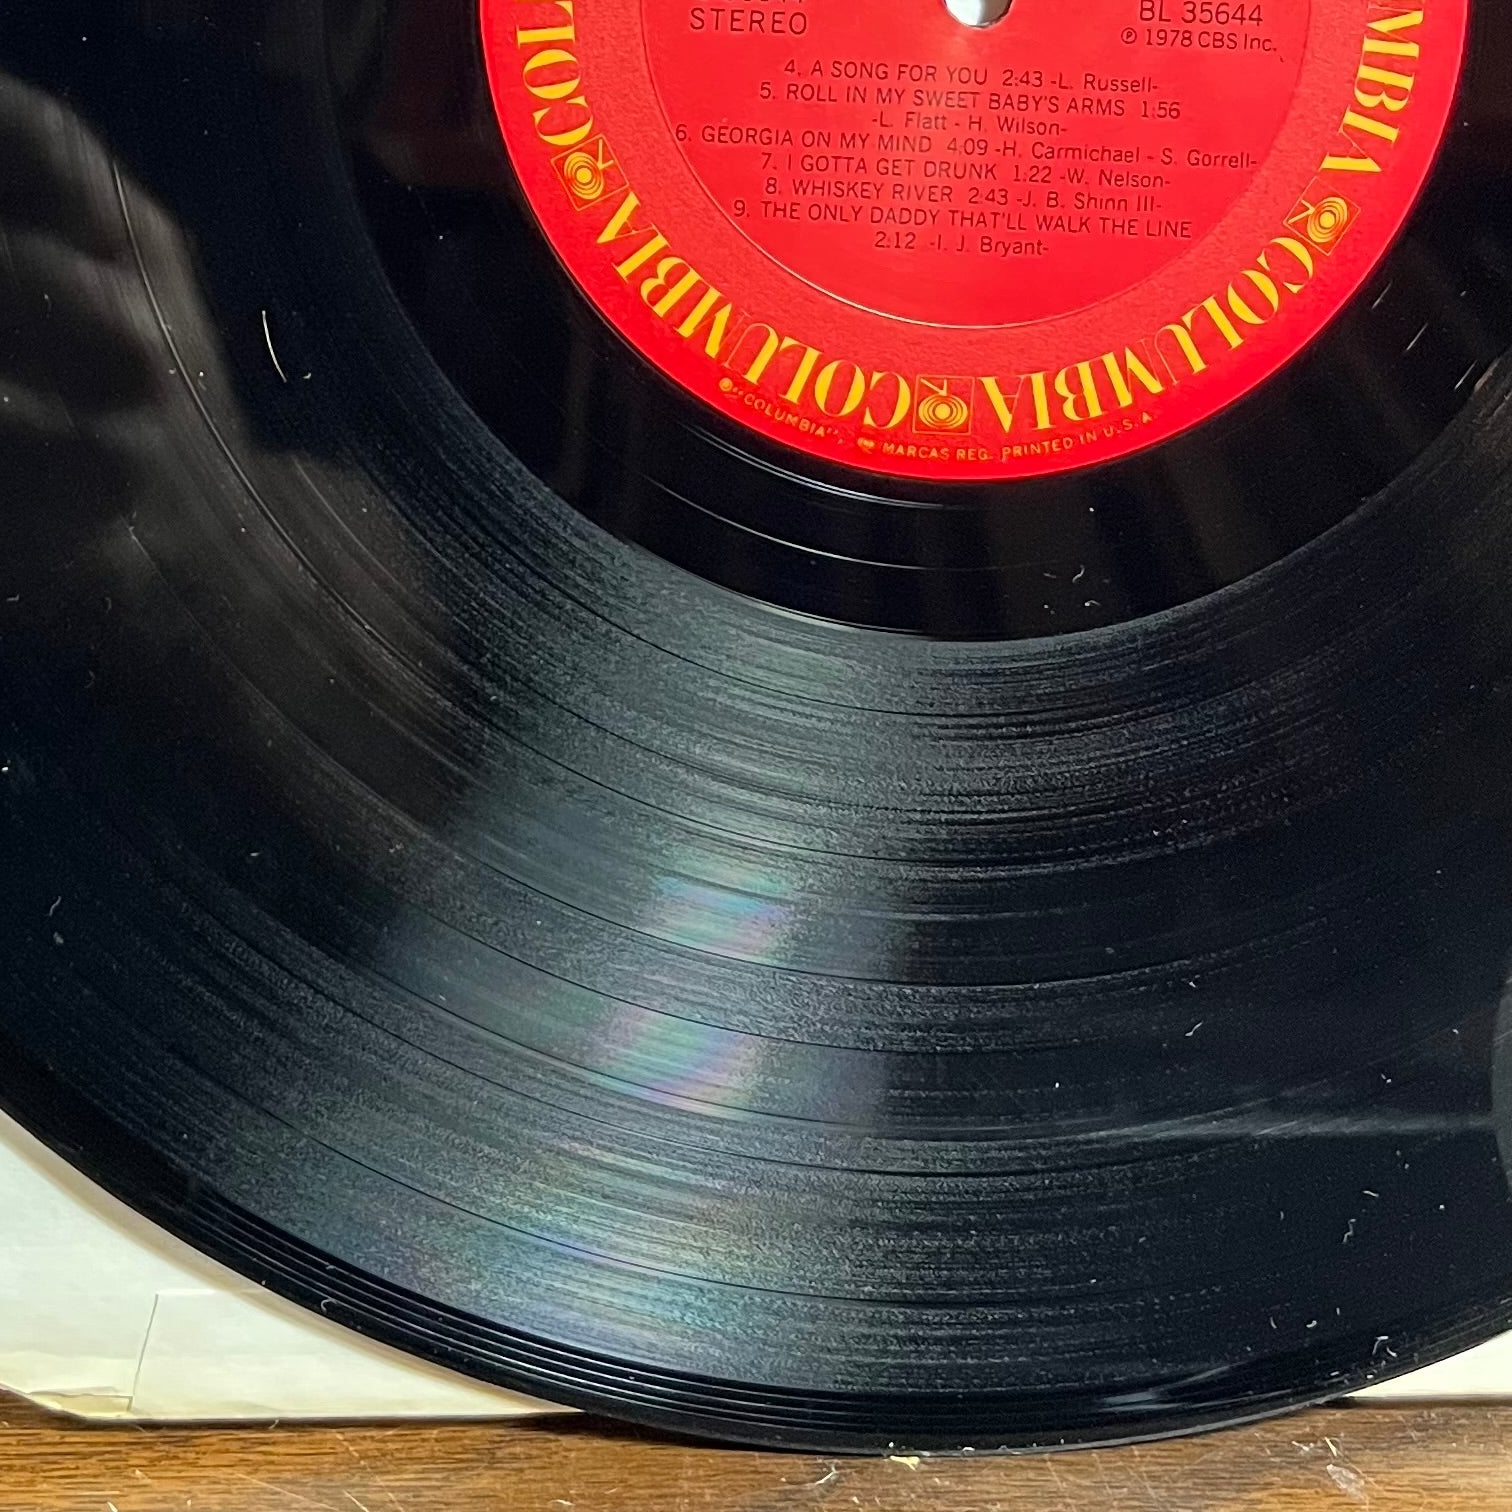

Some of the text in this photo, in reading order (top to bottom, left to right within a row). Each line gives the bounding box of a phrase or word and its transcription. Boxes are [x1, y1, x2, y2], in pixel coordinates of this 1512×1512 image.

[689, 6, 808, 36] STEREO
[1181, 0, 1264, 27] 35644
[1146, 28, 1278, 52] 1978 CBS Inc.
[810, 59, 1158, 93] A SONG FOR YOU Russell-
[786, 82, 1125, 117] ROLL IN MY SWEET BABY'S ARMS
[904, 111, 948, 131] Flatt
[701, 124, 1140, 164] GEORGIA ON MY MIND Carmichael
[787, 153, 997, 181] I GOTTA GET DRUNK
[792, 178, 1128, 212] WHISKEY RIVER Shinn
[760, 200, 1193, 239] THE ONLY DADDY THAT'LL WALK THE LINE
[980, 235, 1049, 258] Bryant-
[596, 193, 911, 431] COLUMBIA
[981, 237, 1316, 433] COLUMBIA
[882, 429, 1098, 461] MARCAS PRINTED IN
